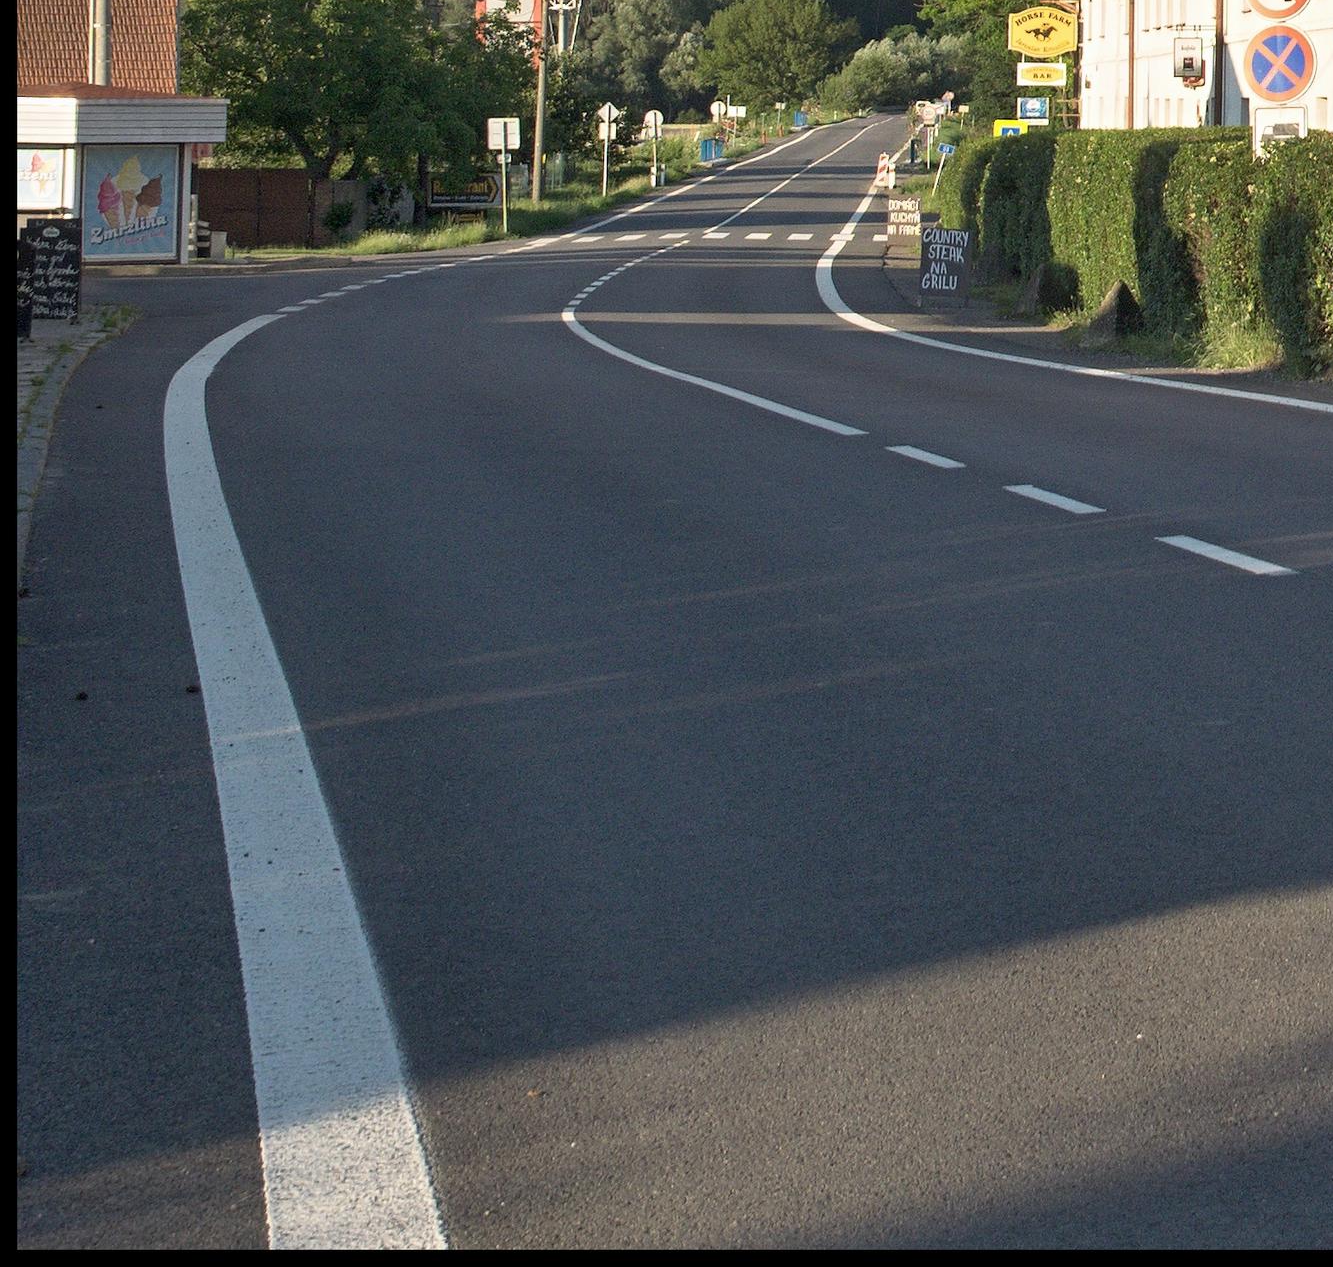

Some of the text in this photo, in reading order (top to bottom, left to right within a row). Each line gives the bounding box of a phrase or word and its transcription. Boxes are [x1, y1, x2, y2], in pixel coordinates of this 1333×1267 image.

[1014, 12, 1072, 27] HORSE FARM
[91, 215, 169, 244] Zmrzlina
[923, 228, 969, 247] COUNTRY
[928, 244, 964, 263] STEAK
[930, 261, 947, 275] NA
[922, 273, 958, 290] GRILU
